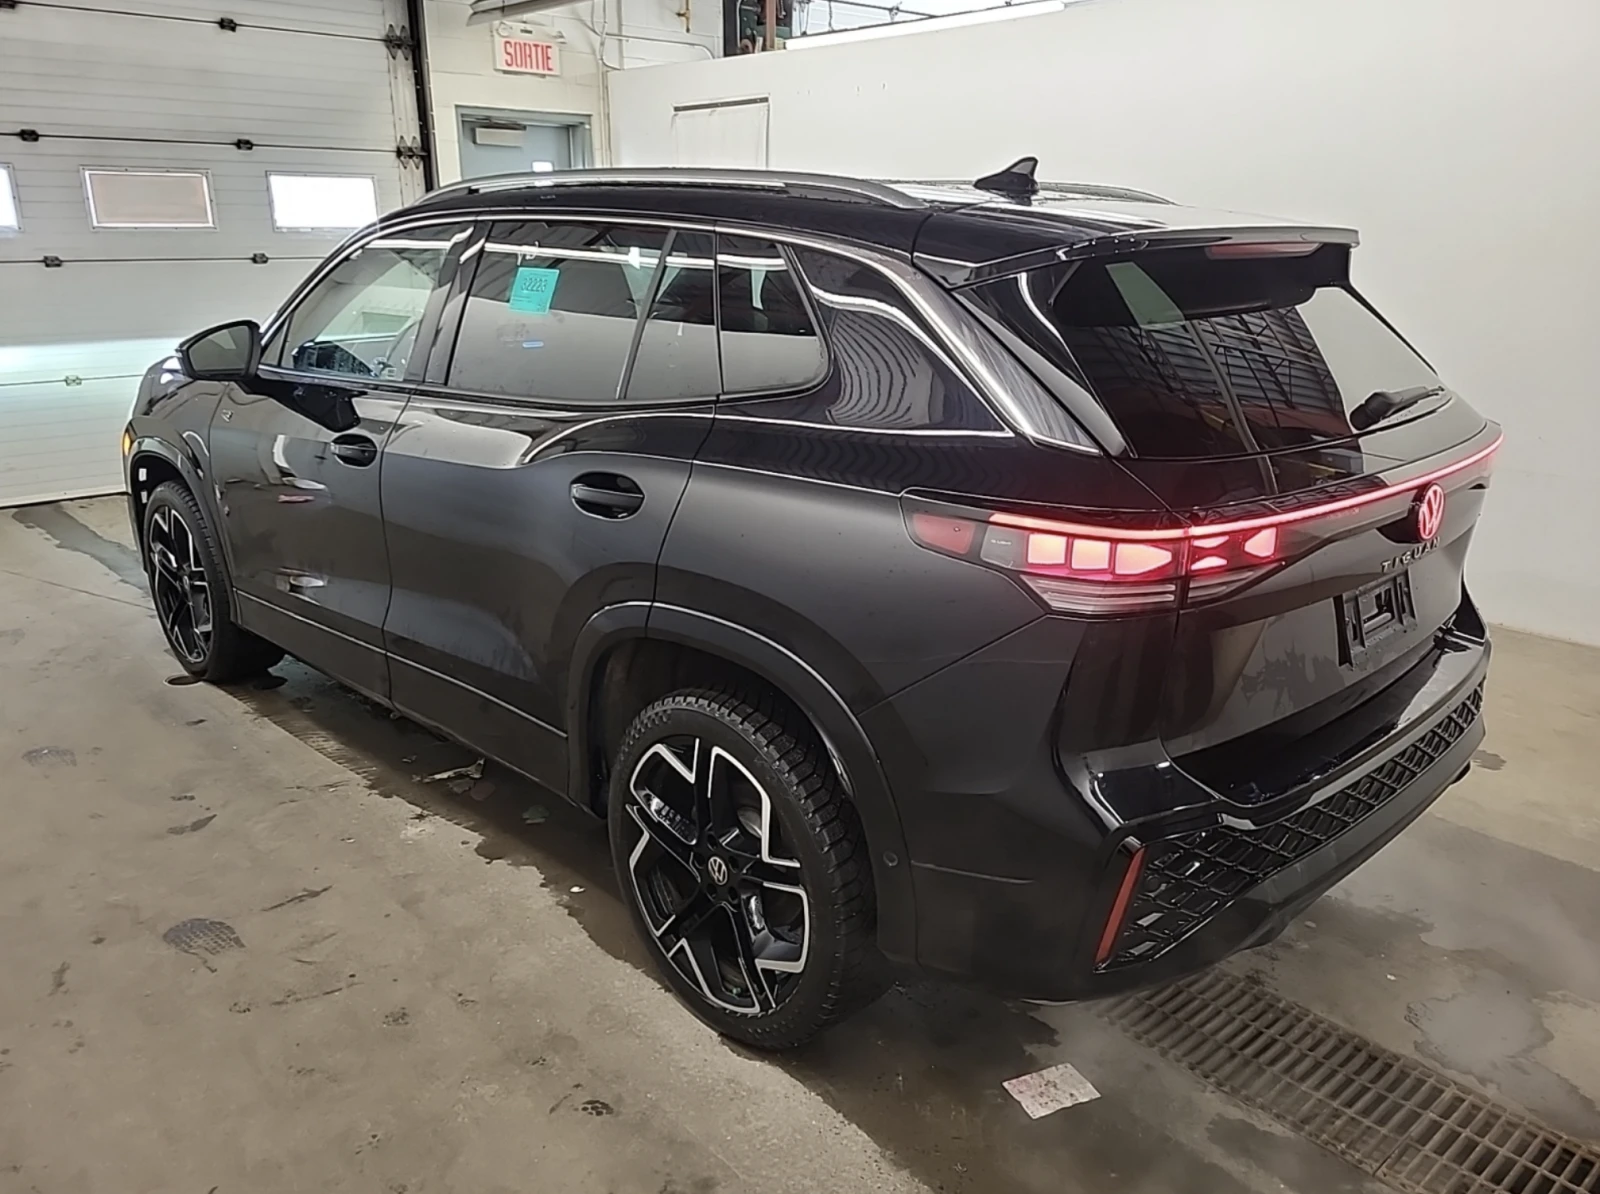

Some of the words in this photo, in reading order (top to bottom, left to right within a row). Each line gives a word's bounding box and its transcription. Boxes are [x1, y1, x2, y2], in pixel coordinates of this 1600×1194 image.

[504, 40, 554, 71] SORTIE
[1420, 484, 1444, 539] VW
[1381, 536, 1440, 573] TIGUAN
[708, 856, 728, 885] VW
